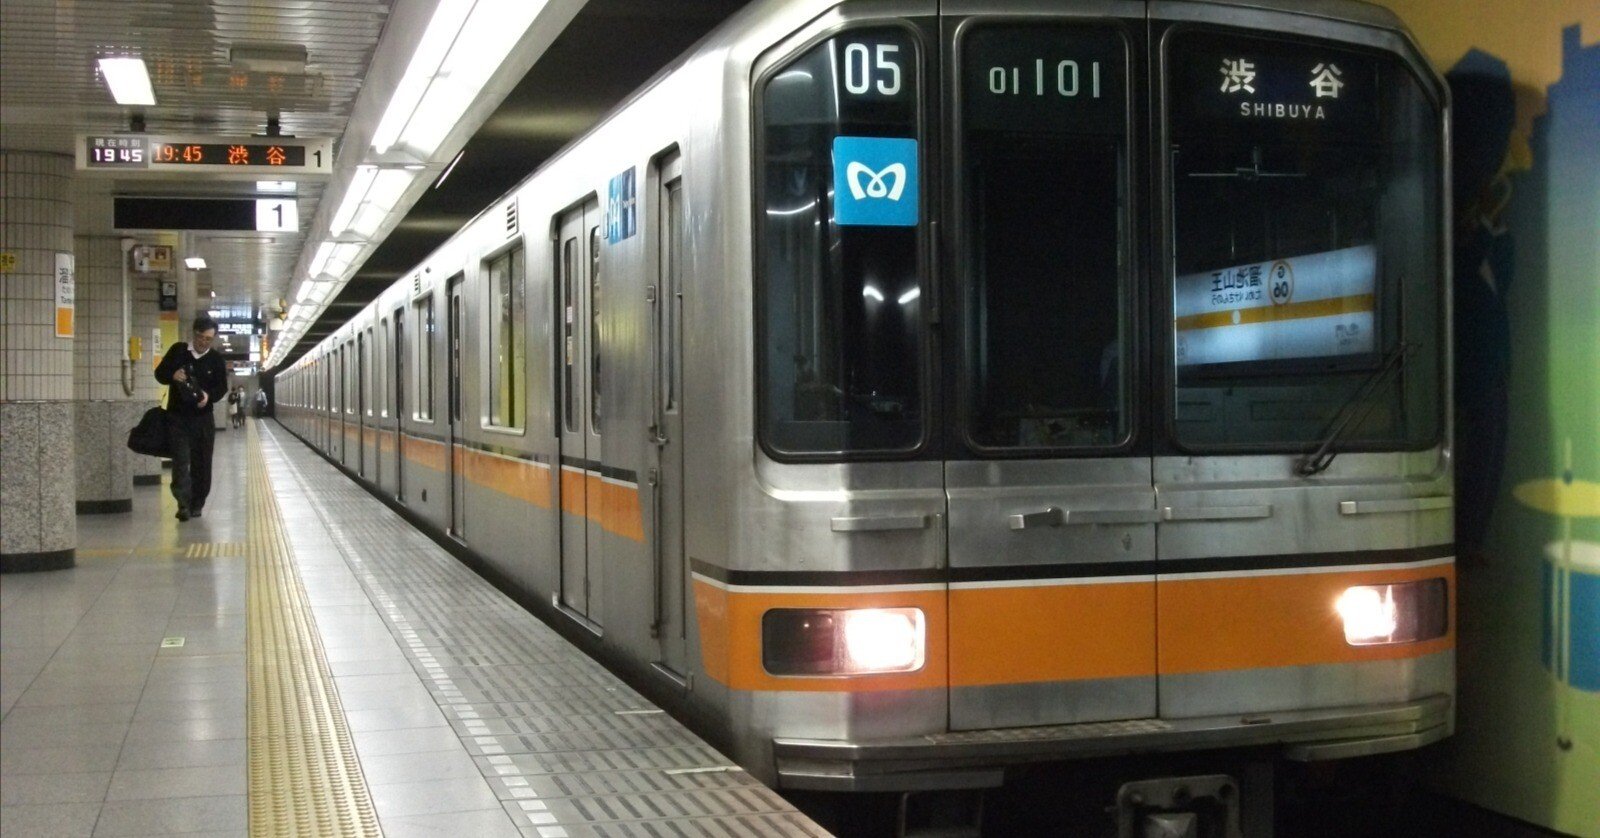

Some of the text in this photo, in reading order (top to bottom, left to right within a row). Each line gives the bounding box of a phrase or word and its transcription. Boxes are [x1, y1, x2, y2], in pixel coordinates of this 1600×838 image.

[844, 43, 902, 96] 05
[1219, 58, 1345, 98] 渋谷
[1240, 102, 1326, 120] SHIBUYA
[154, 145, 286, 165] 19:45 渋谷
[313, 150, 322, 168] 1
[272, 204, 282, 227] 1
